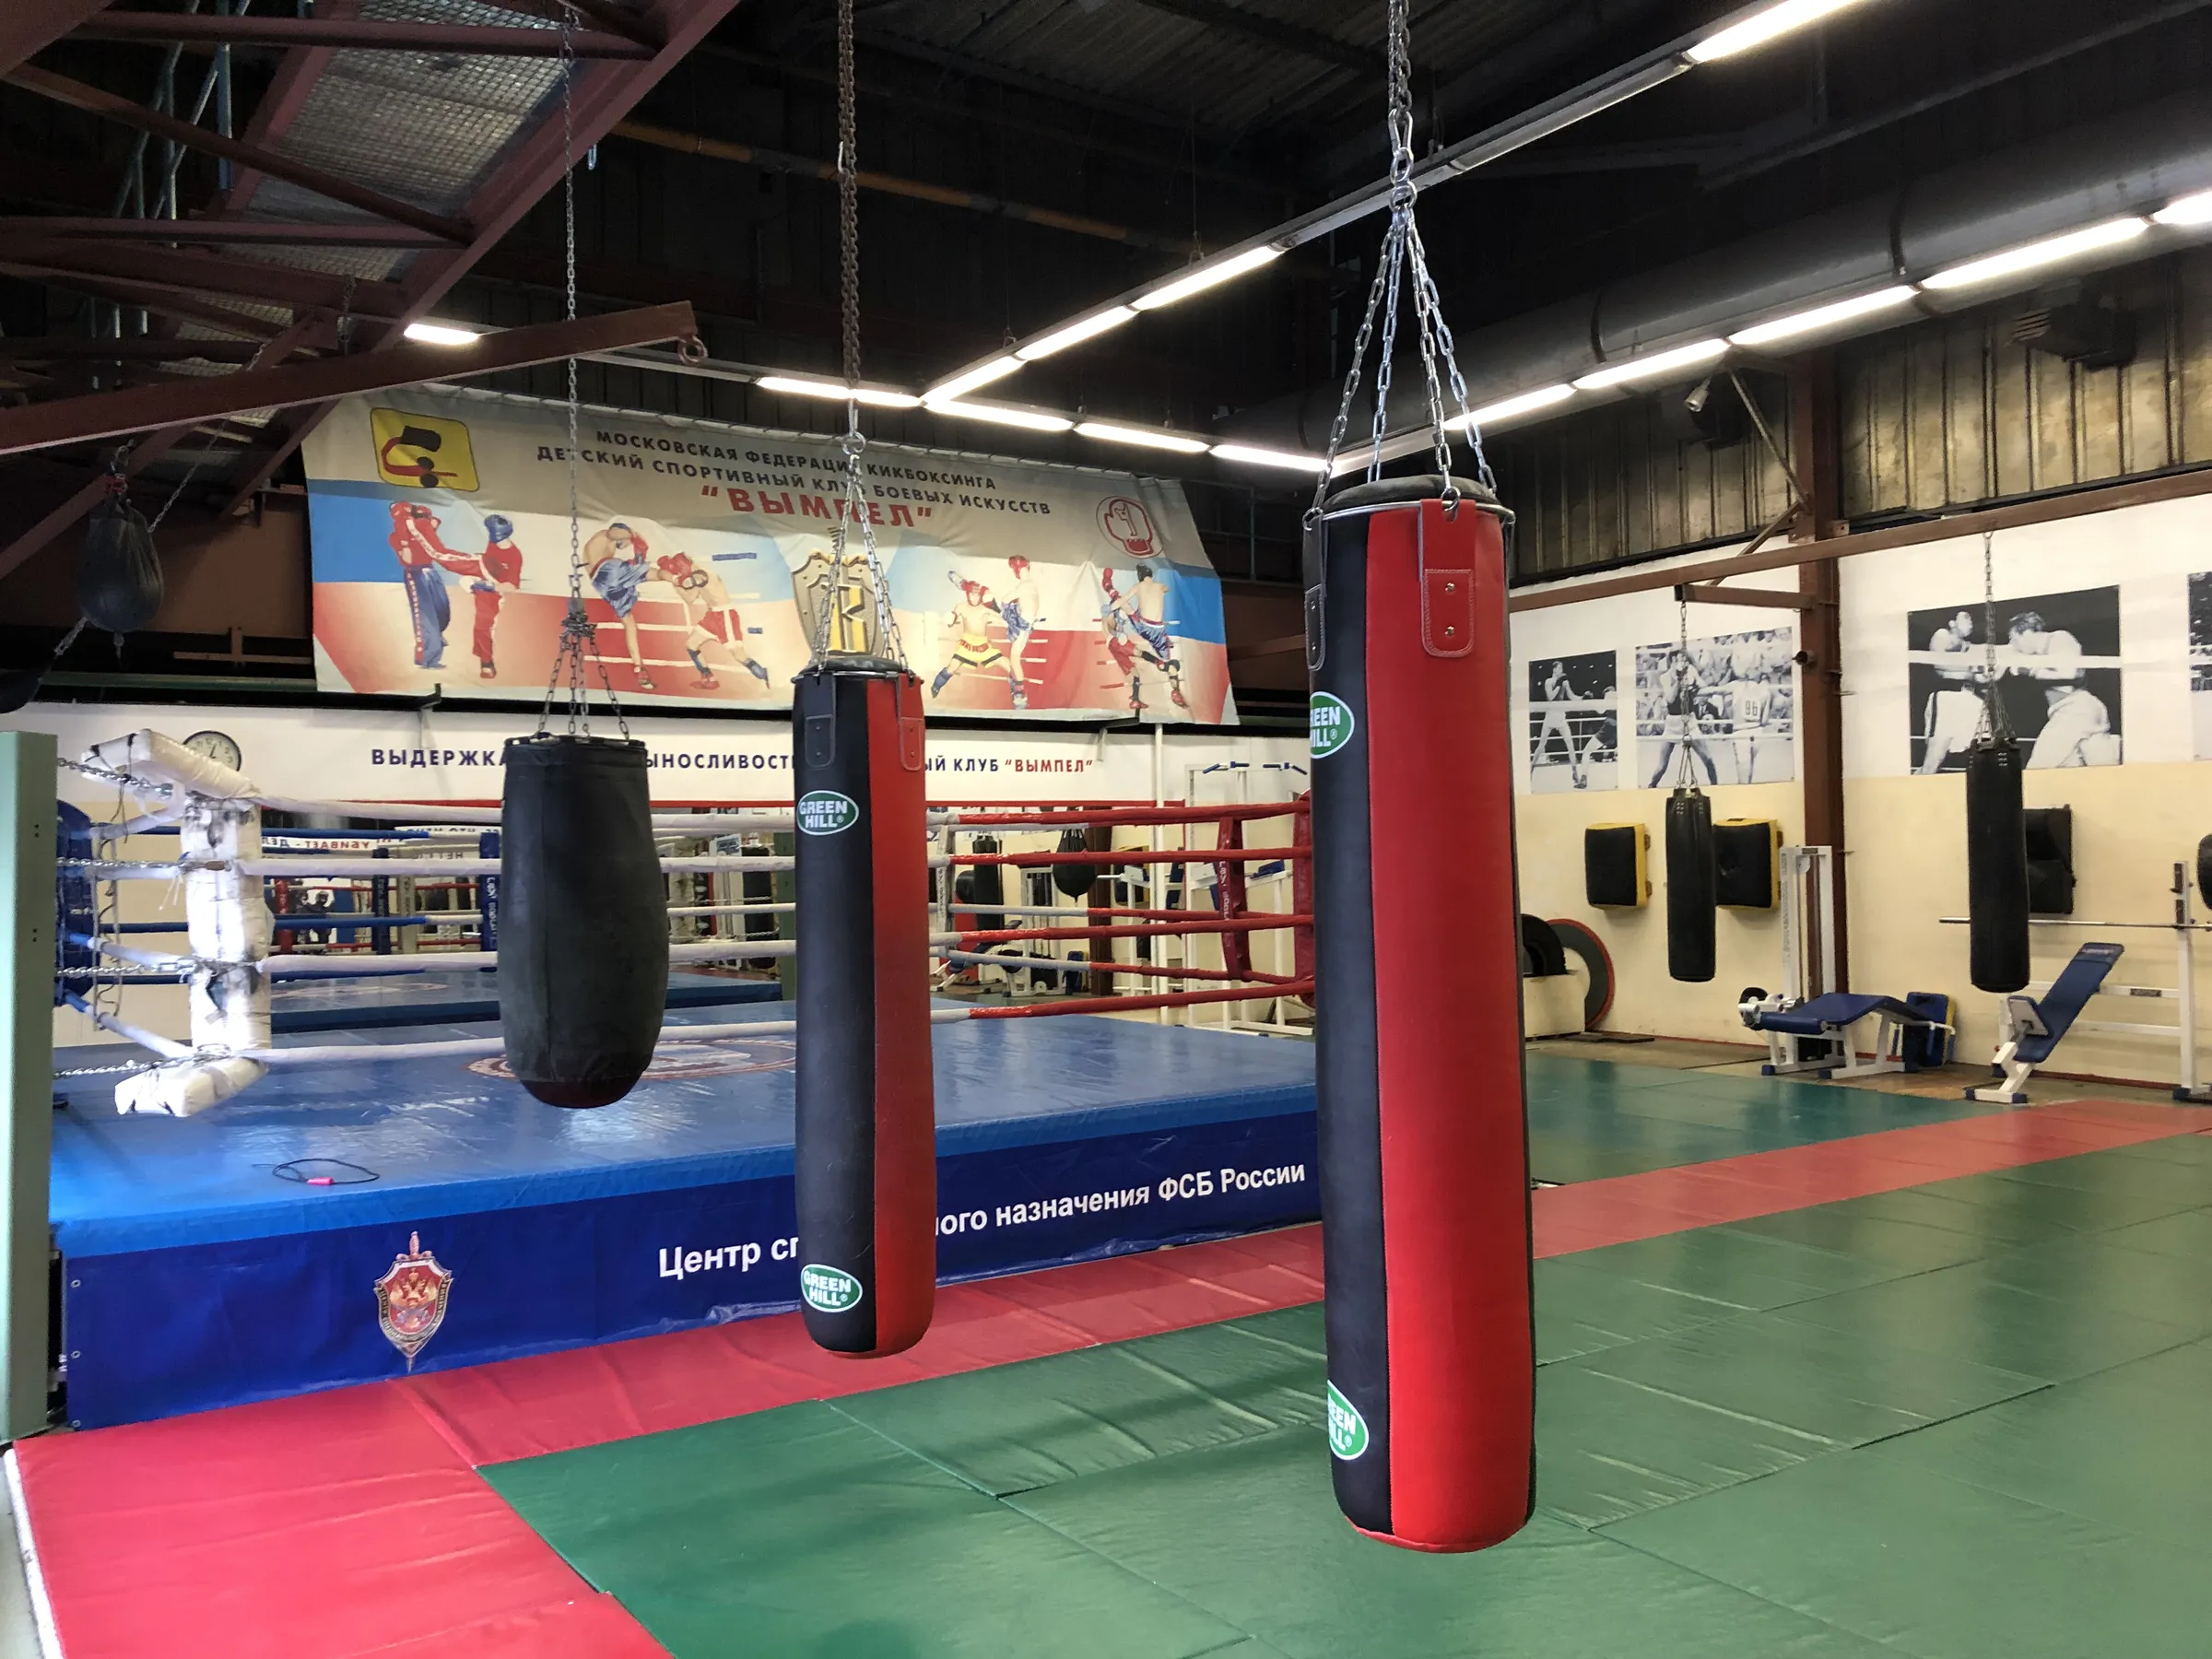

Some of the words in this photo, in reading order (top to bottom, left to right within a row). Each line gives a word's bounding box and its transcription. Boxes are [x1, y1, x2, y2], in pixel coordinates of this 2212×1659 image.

[596, 430, 737, 461] МОСКОВСКАЯ
[745, 450, 849, 474] ФЕДЕРАЦИ
[866, 464, 996, 489] КИКБОКСИНГА
[653, 460, 805, 489] СПОРТИВНЫЙ
[812, 477, 866, 496] КЛУ
[873, 485, 953, 505] БОЕВЫХ
[959, 494, 1051, 515] ИСКУССТВ
[646, 753, 794, 769] ЫНОСЛИВОСТ
[953, 759, 999, 772] КЛУБ
[799, 800, 848, 815] GREEN
[659, 1241, 761, 1280] Центр
[995, 1186, 1150, 1227] назначения
[1158, 1171, 1214, 1201] ФСБ
[1220, 1164, 1305, 1193] России
[803, 1270, 852, 1293] GREEN
